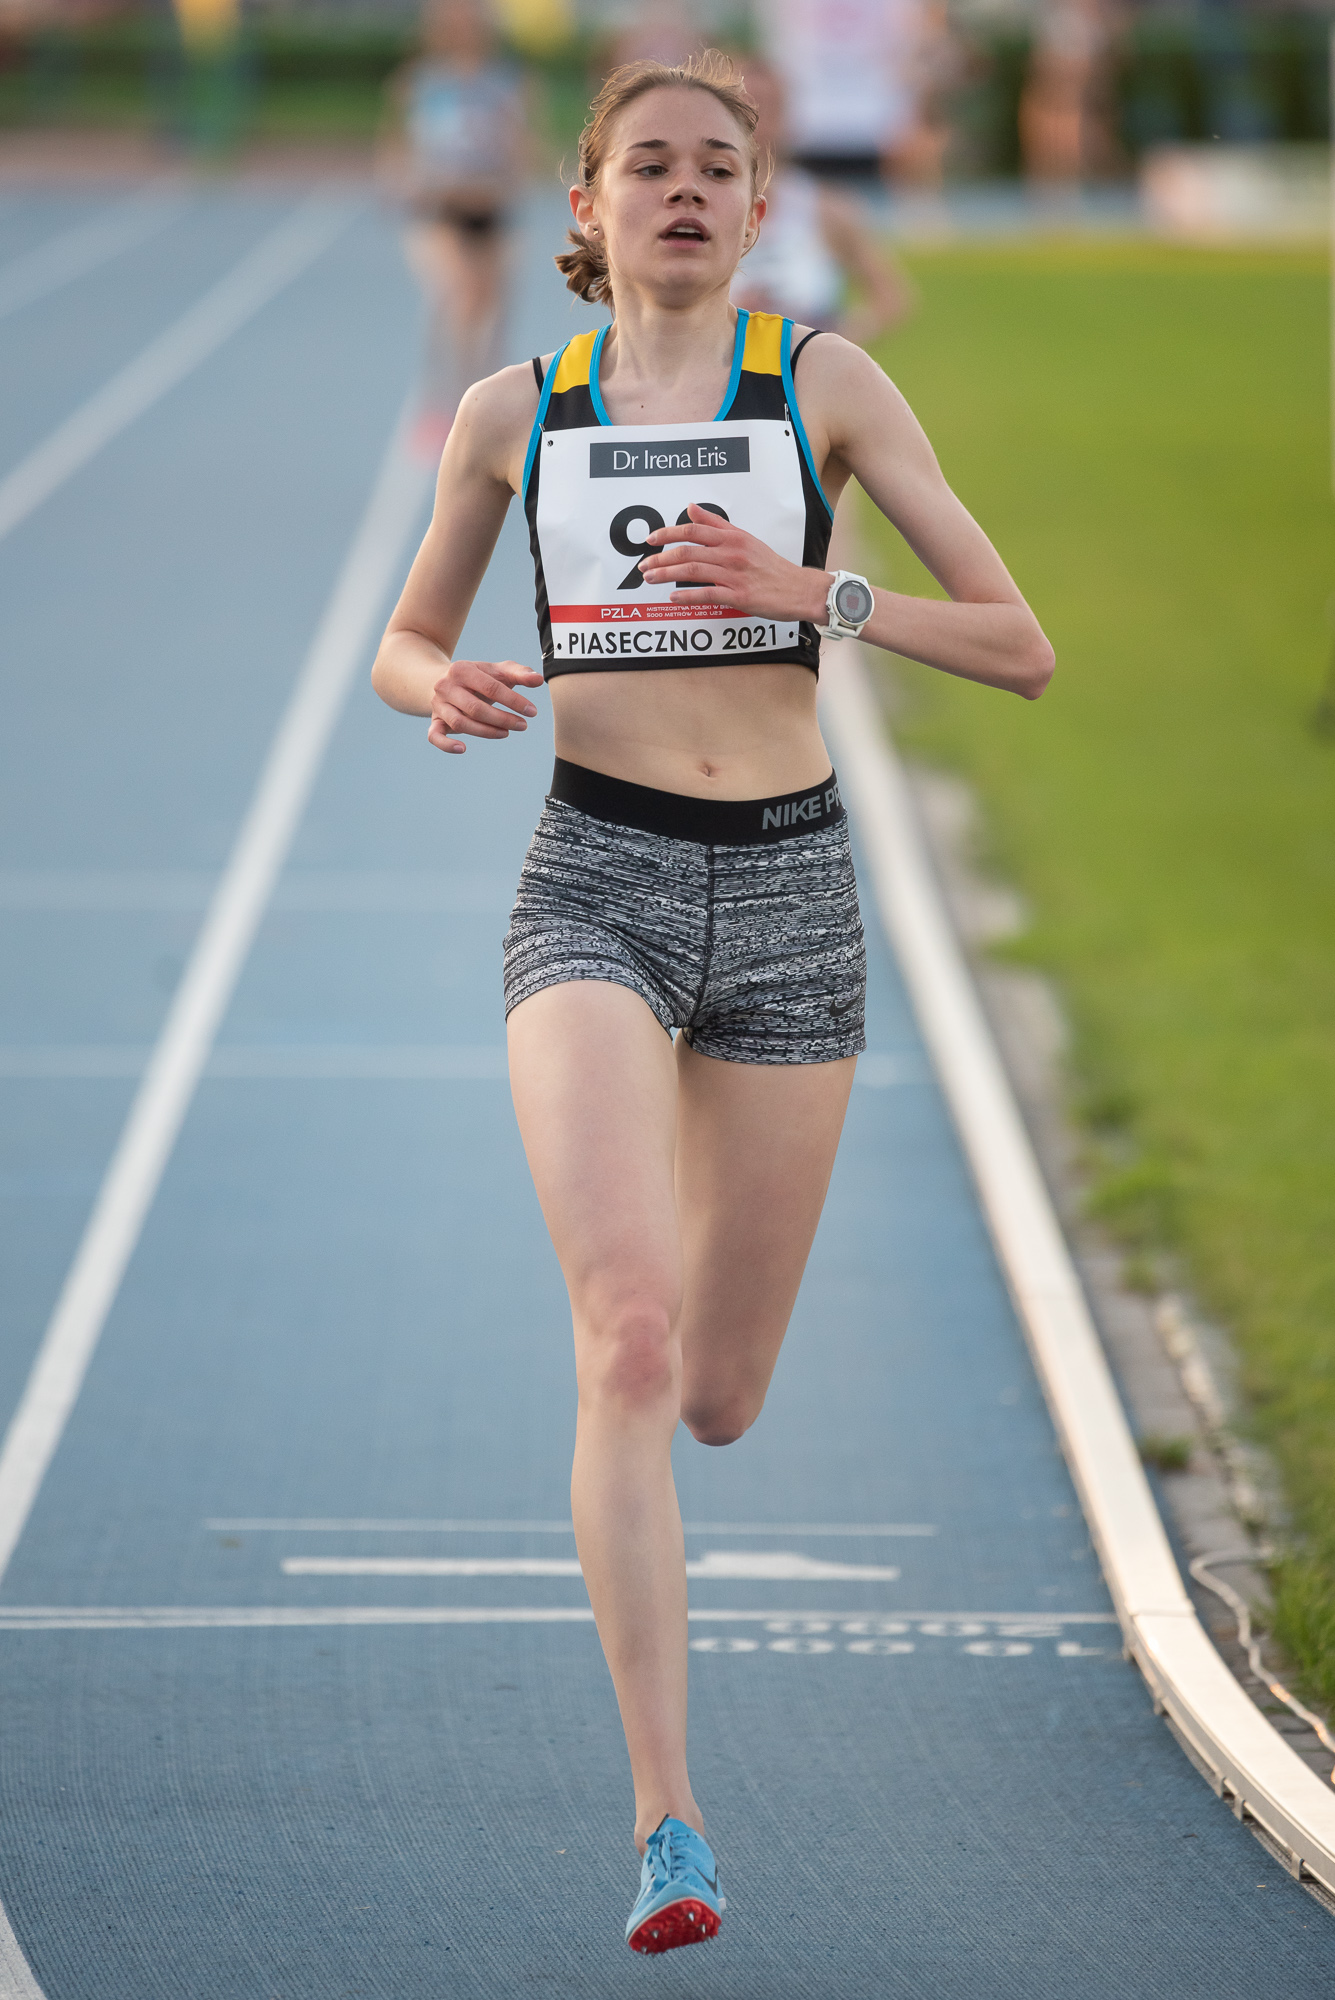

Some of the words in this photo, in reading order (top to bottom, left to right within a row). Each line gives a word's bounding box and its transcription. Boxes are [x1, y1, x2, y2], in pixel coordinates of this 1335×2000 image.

[613, 450, 639, 470] Dr
[644, 450, 692, 470] Irena
[697, 446, 728, 467] Eris
[601, 607, 642, 619] PZLA
[568, 629, 713, 655] PIASECZNO
[722, 624, 777, 650] 2021
[762, 795, 822, 830] NIKE
